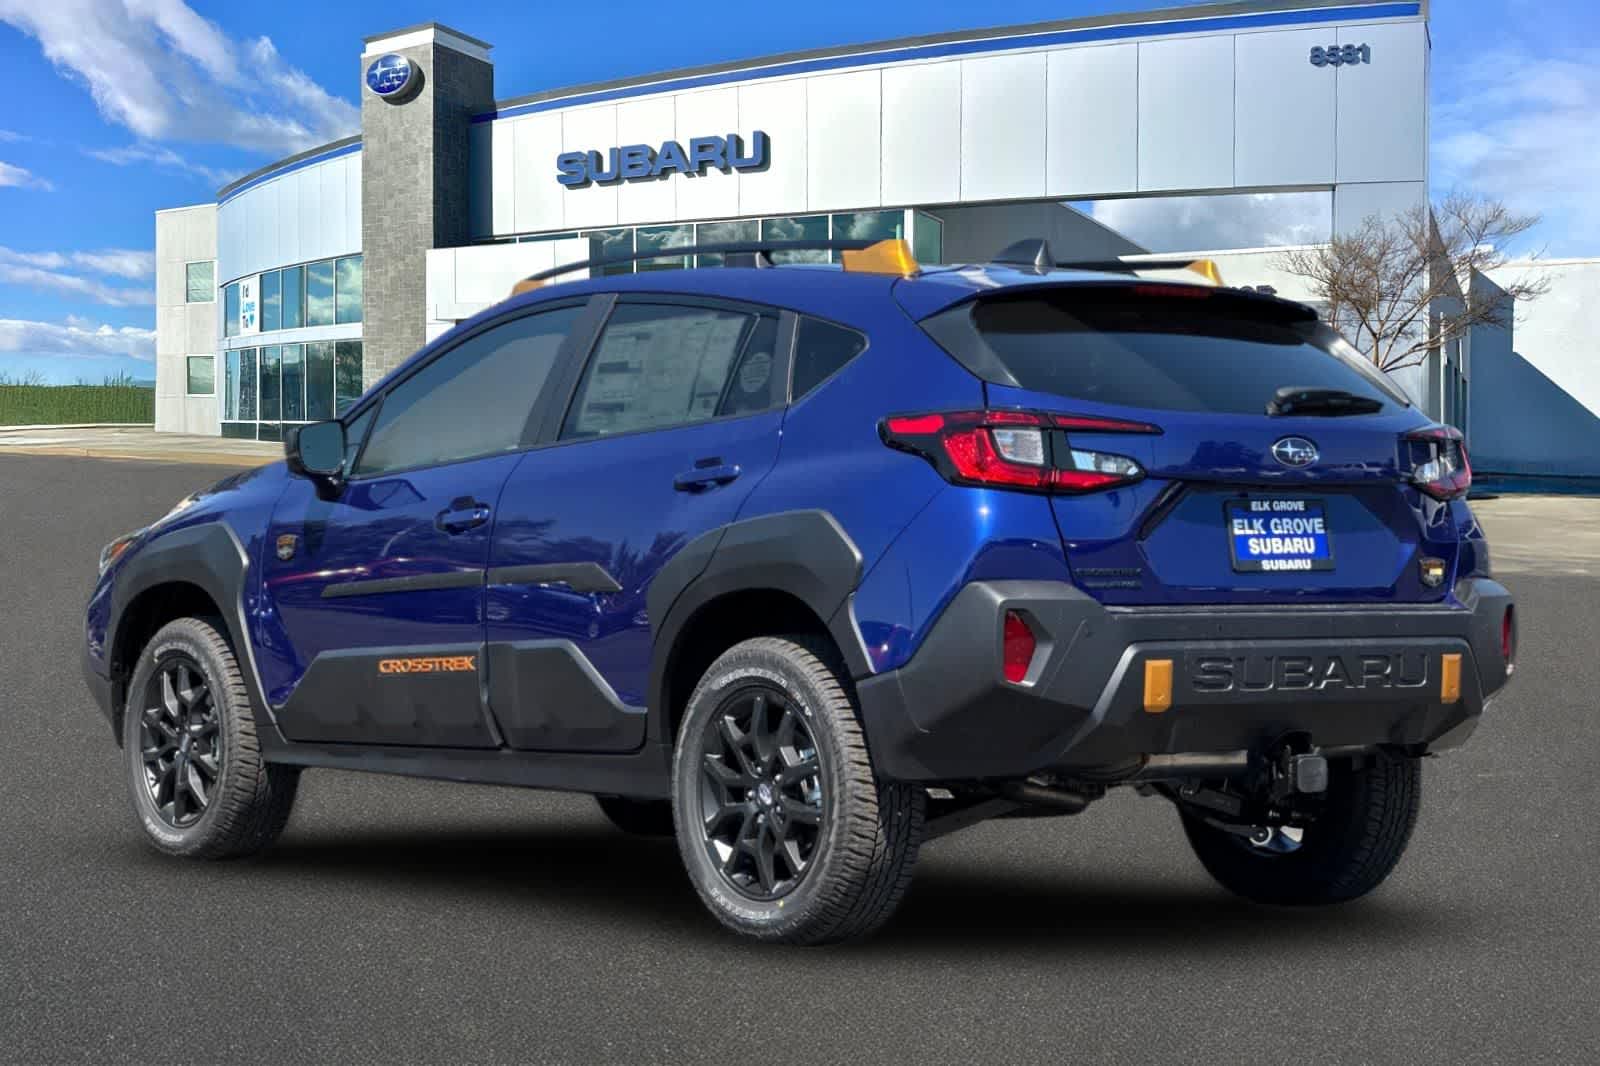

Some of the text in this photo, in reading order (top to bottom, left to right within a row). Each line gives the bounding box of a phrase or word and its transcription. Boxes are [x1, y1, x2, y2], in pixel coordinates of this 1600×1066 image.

[556, 130, 769, 188] SUBARU
[1251, 501, 1305, 511] ELK GROVE
[1233, 518, 1325, 535] ELK GROVE
[1248, 537, 1315, 555] SUBARU
[1262, 559, 1312, 570] SUBARU
[379, 656, 476, 672] CROSSTREK
[1193, 654, 1430, 692] SUBARU
